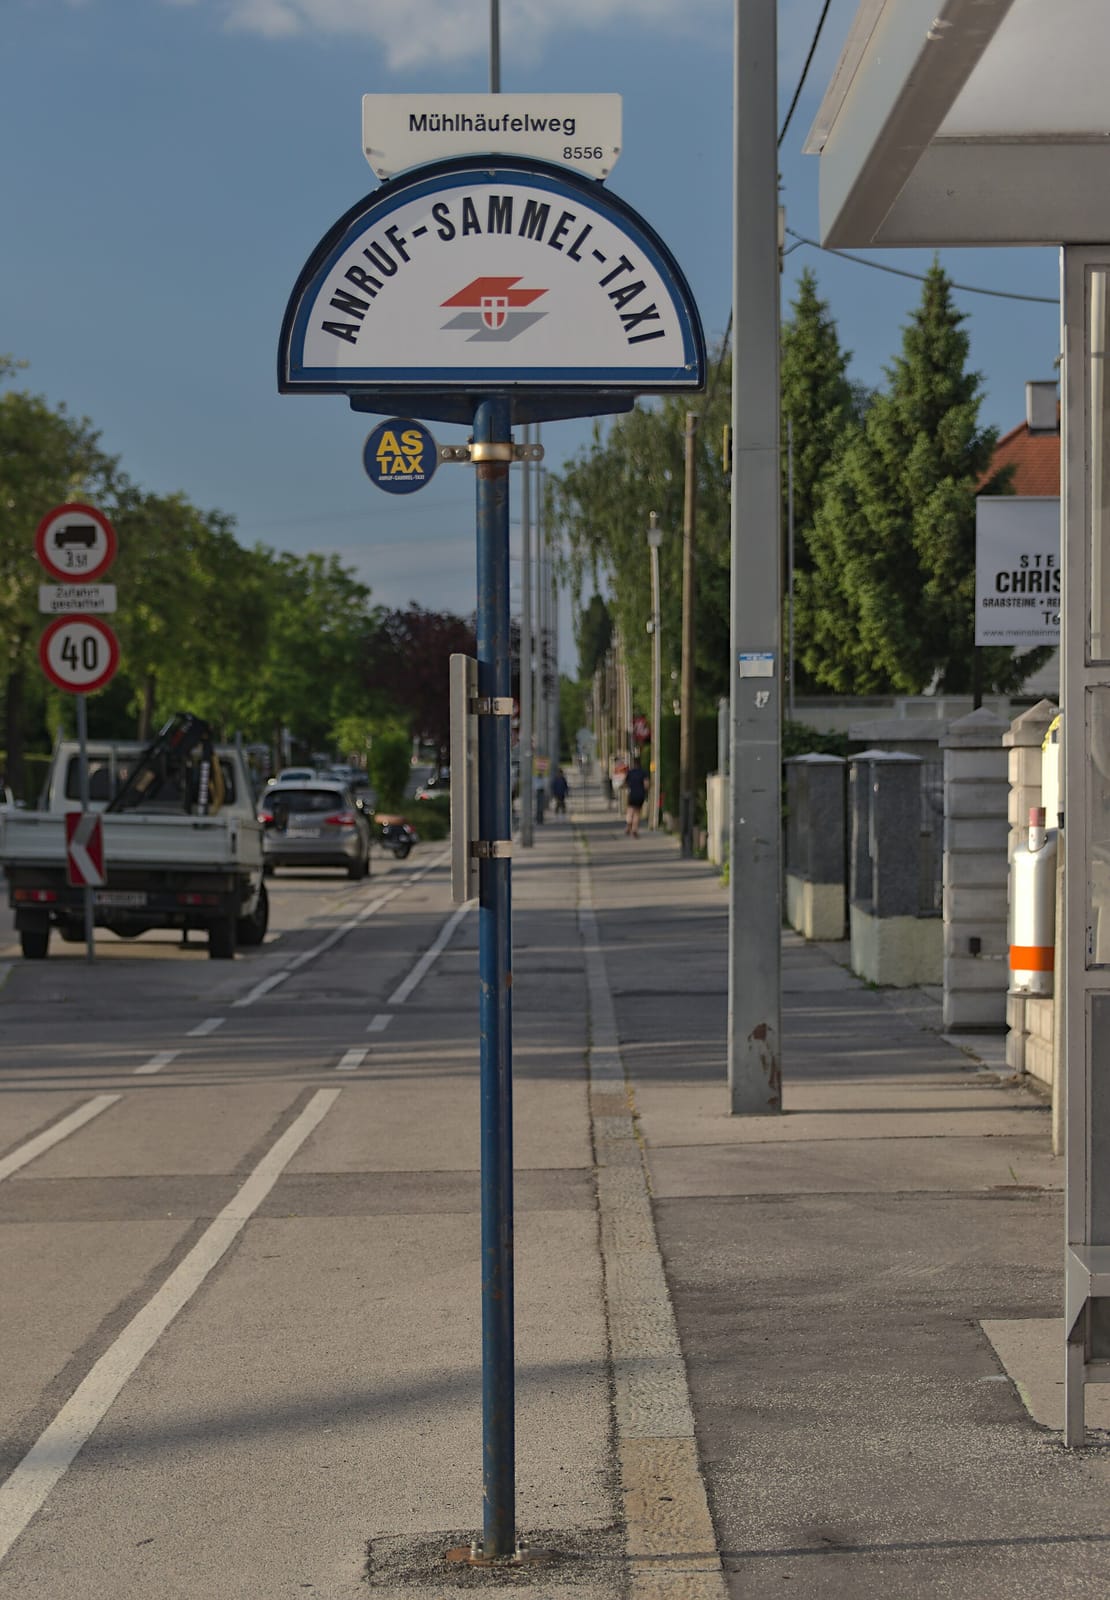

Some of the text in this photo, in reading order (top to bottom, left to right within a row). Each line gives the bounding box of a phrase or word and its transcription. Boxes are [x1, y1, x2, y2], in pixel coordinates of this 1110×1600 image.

[409, 113, 576, 136] Mühlhäufelweg
[562, 147, 604, 160] 8556
[321, 195, 666, 345] ANRUF-SAMMEL-TAXI
[376, 430, 424, 456] AS
[375, 455, 424, 474] TAX
[982, 598, 1036, 608] GRABSTEINE
[61, 635, 98, 671] 40
